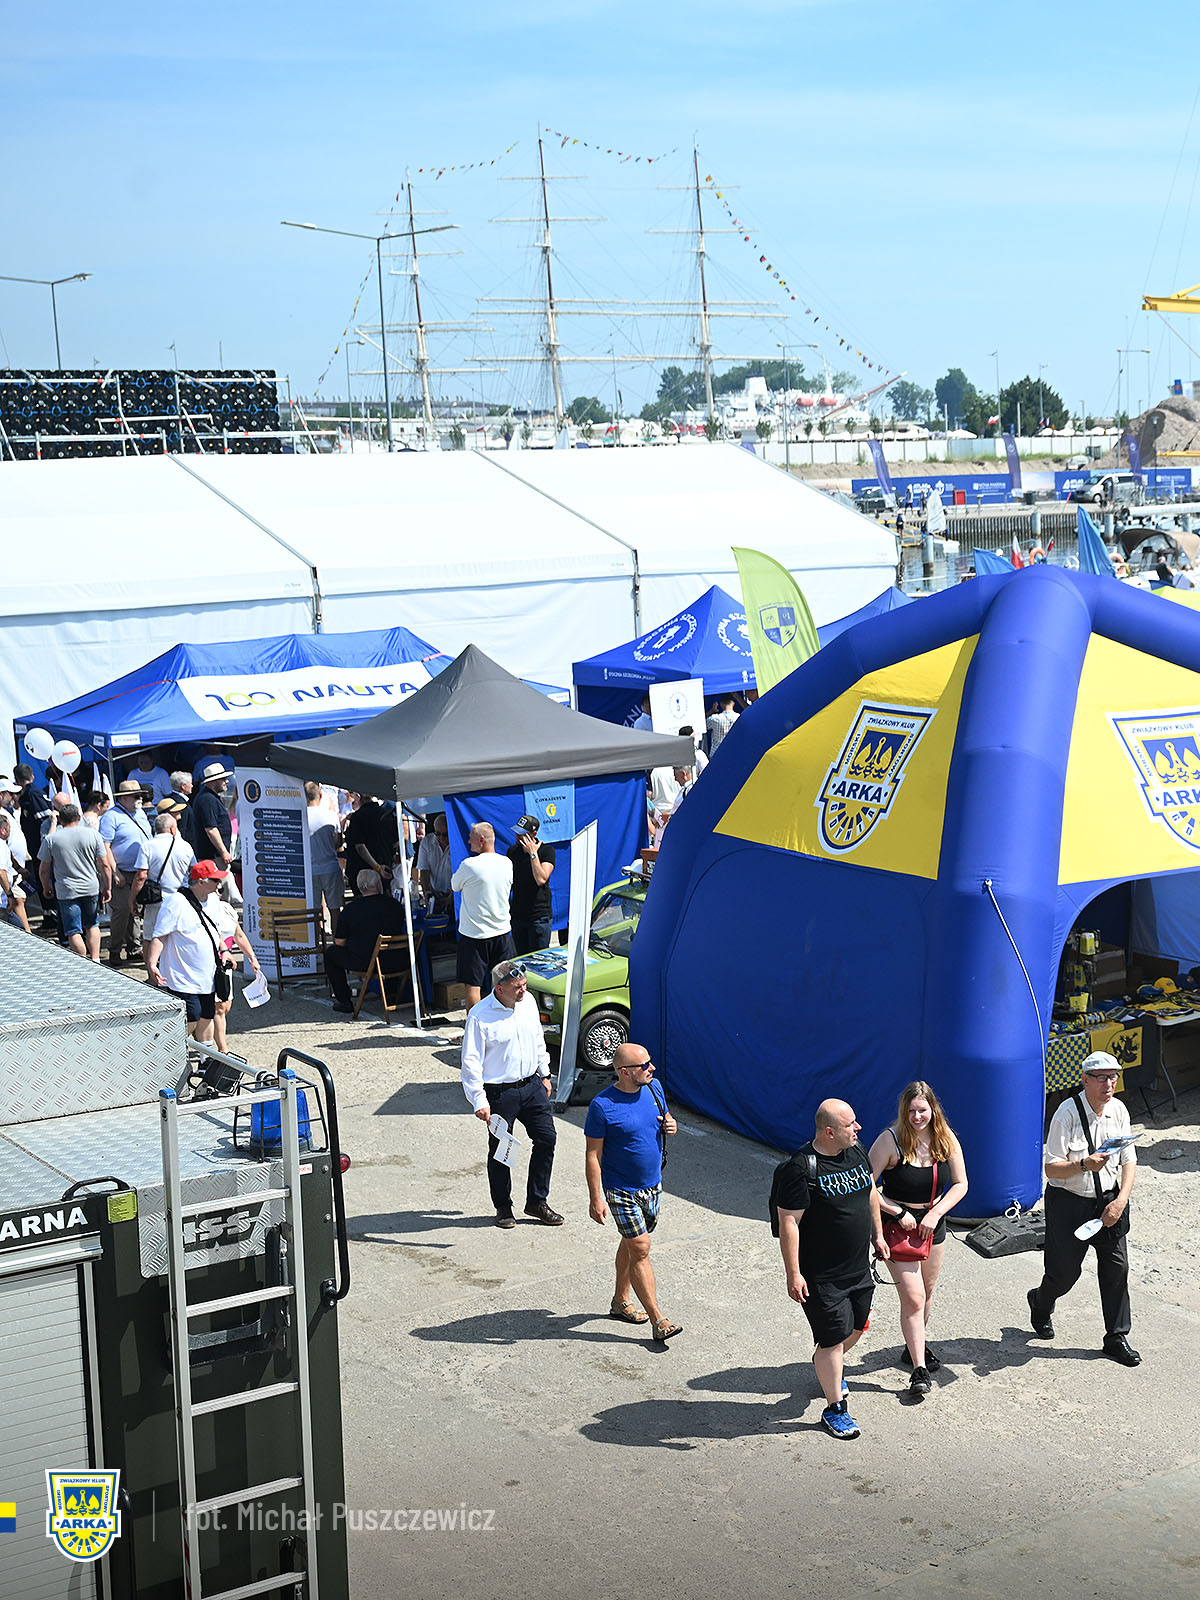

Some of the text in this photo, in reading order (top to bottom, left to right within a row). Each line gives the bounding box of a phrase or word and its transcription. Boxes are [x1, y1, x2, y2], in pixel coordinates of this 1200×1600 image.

[292, 682, 419, 702] NAUTA
[900, 721, 915, 729] KLUB
[833, 780, 883, 803] ARKA
